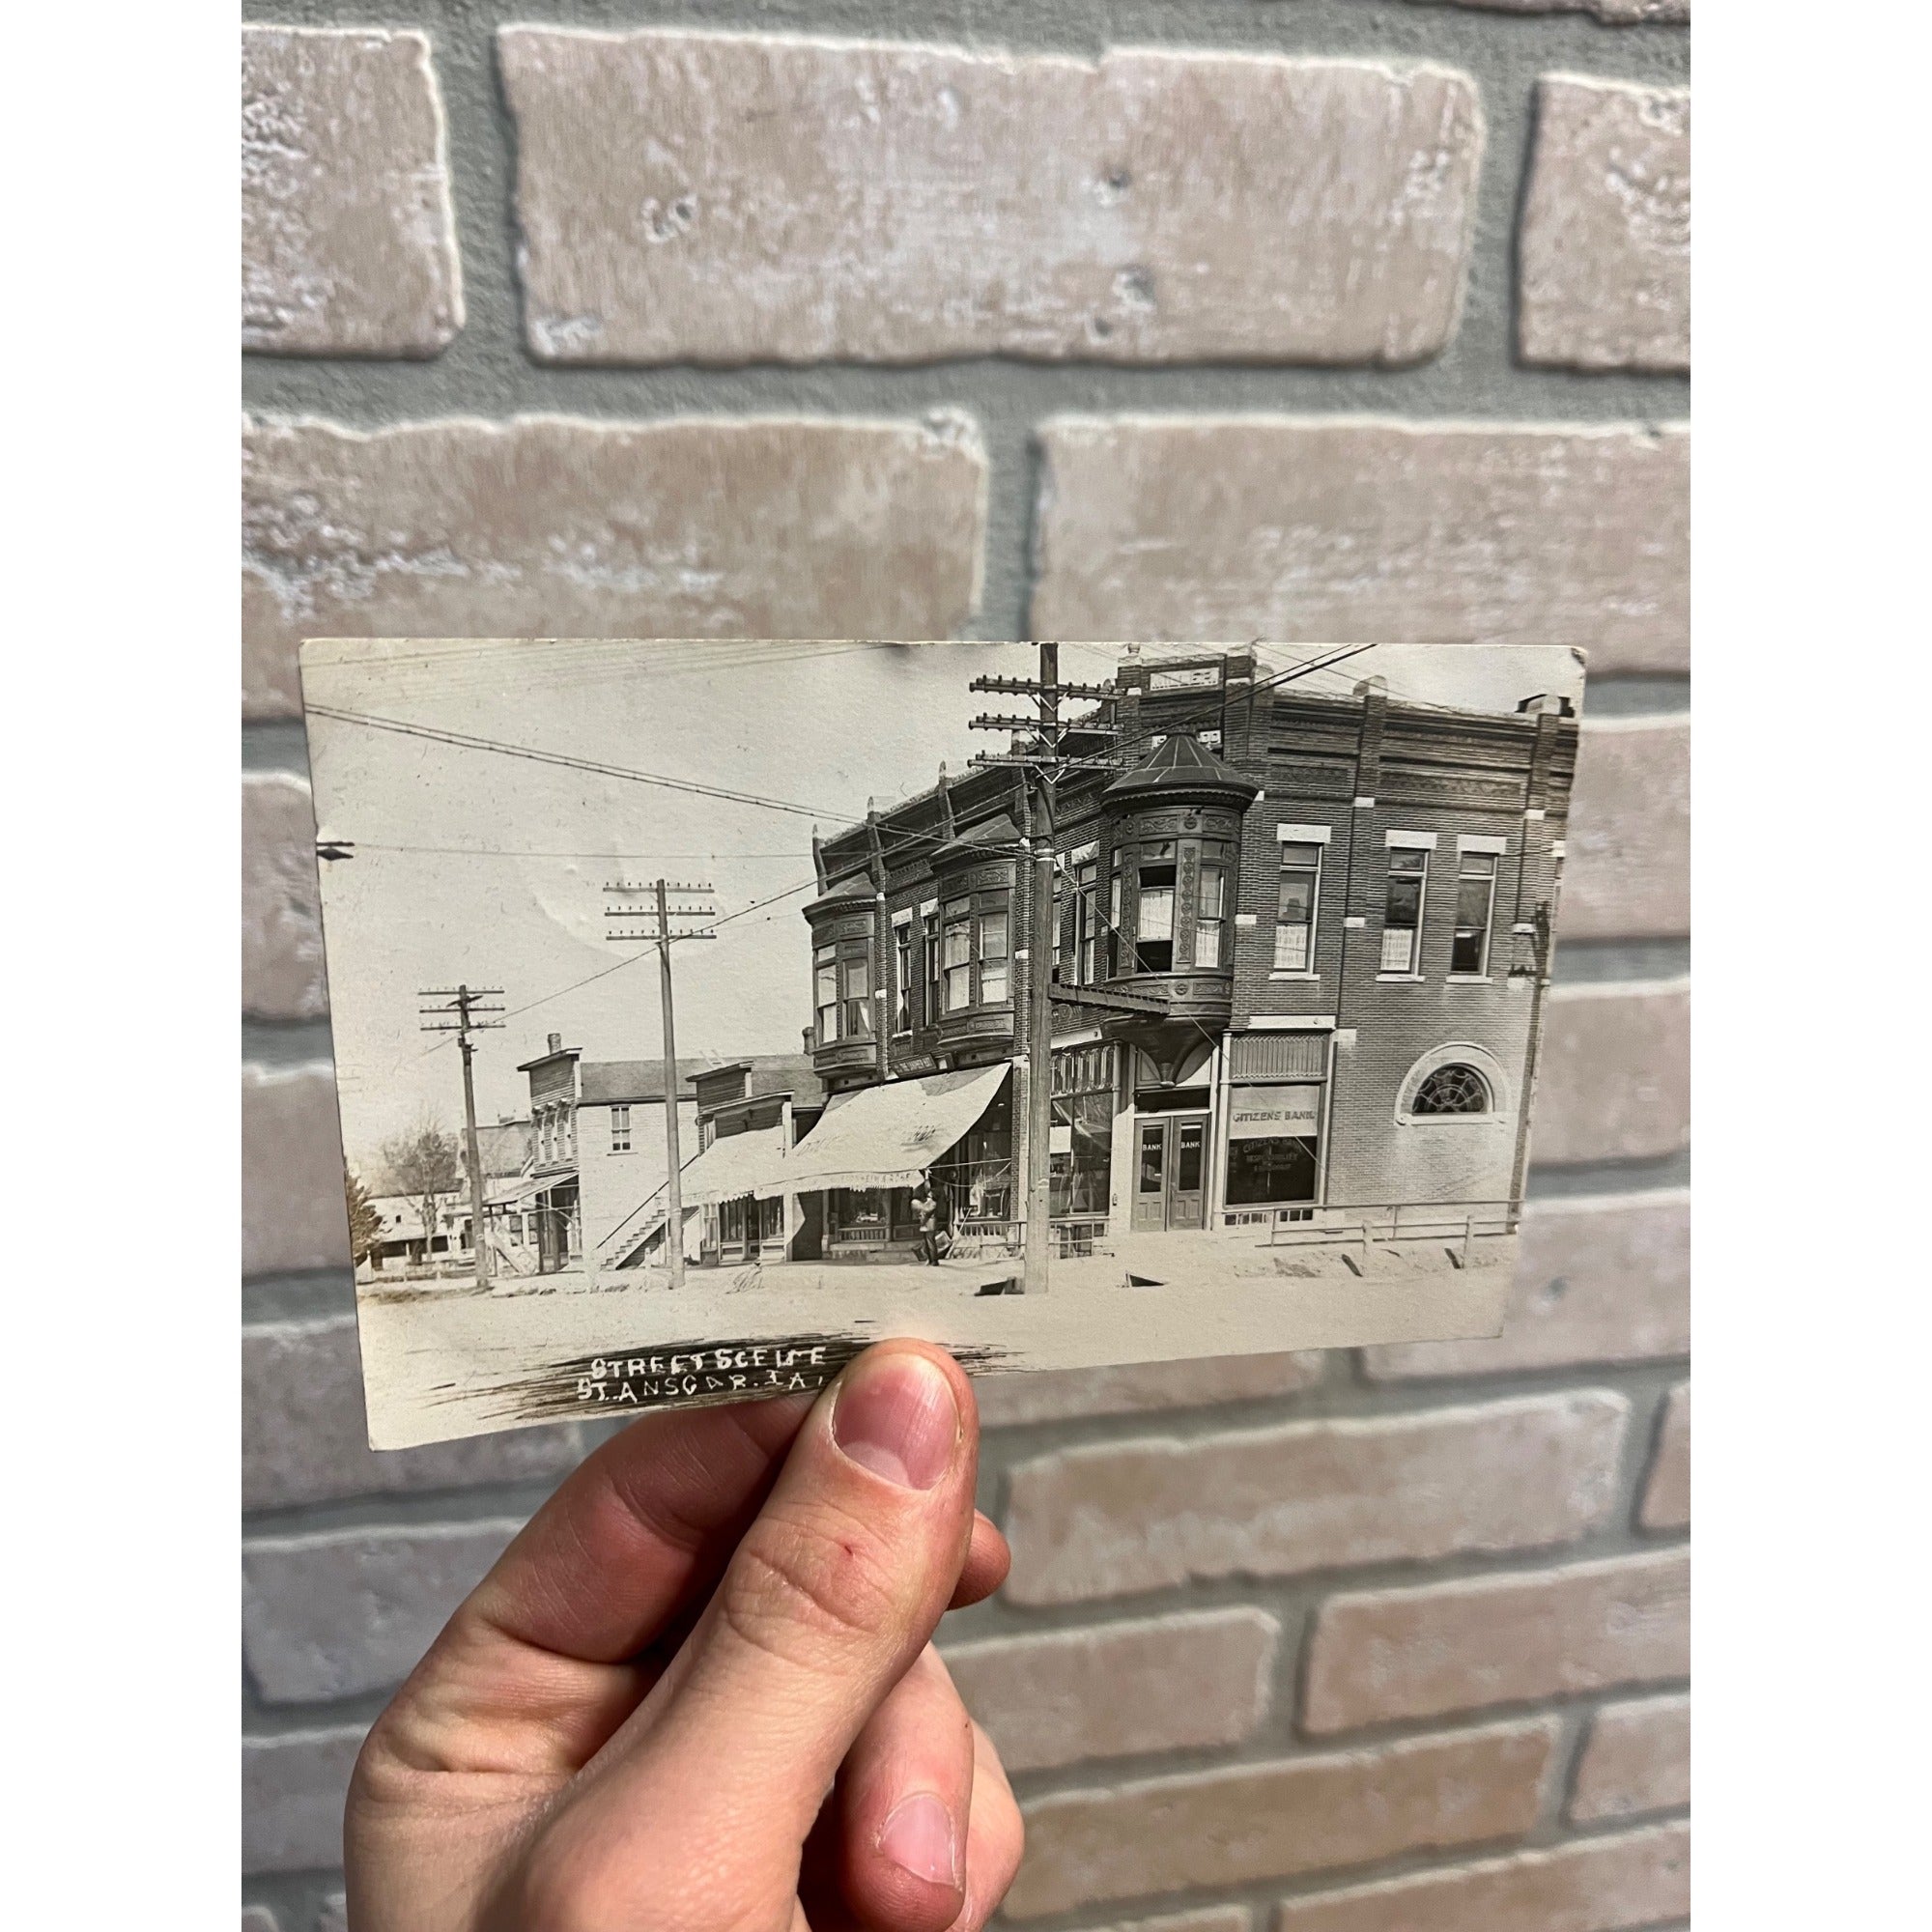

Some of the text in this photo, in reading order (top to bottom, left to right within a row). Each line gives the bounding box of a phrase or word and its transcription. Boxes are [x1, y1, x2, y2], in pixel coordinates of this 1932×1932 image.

[1233, 1110, 1316, 1122] CITIZENS BANK
[1142, 1143, 1162, 1151] BANK
[1180, 1141, 1201, 1150] BANK
[591, 1352, 706, 1379] STREET
